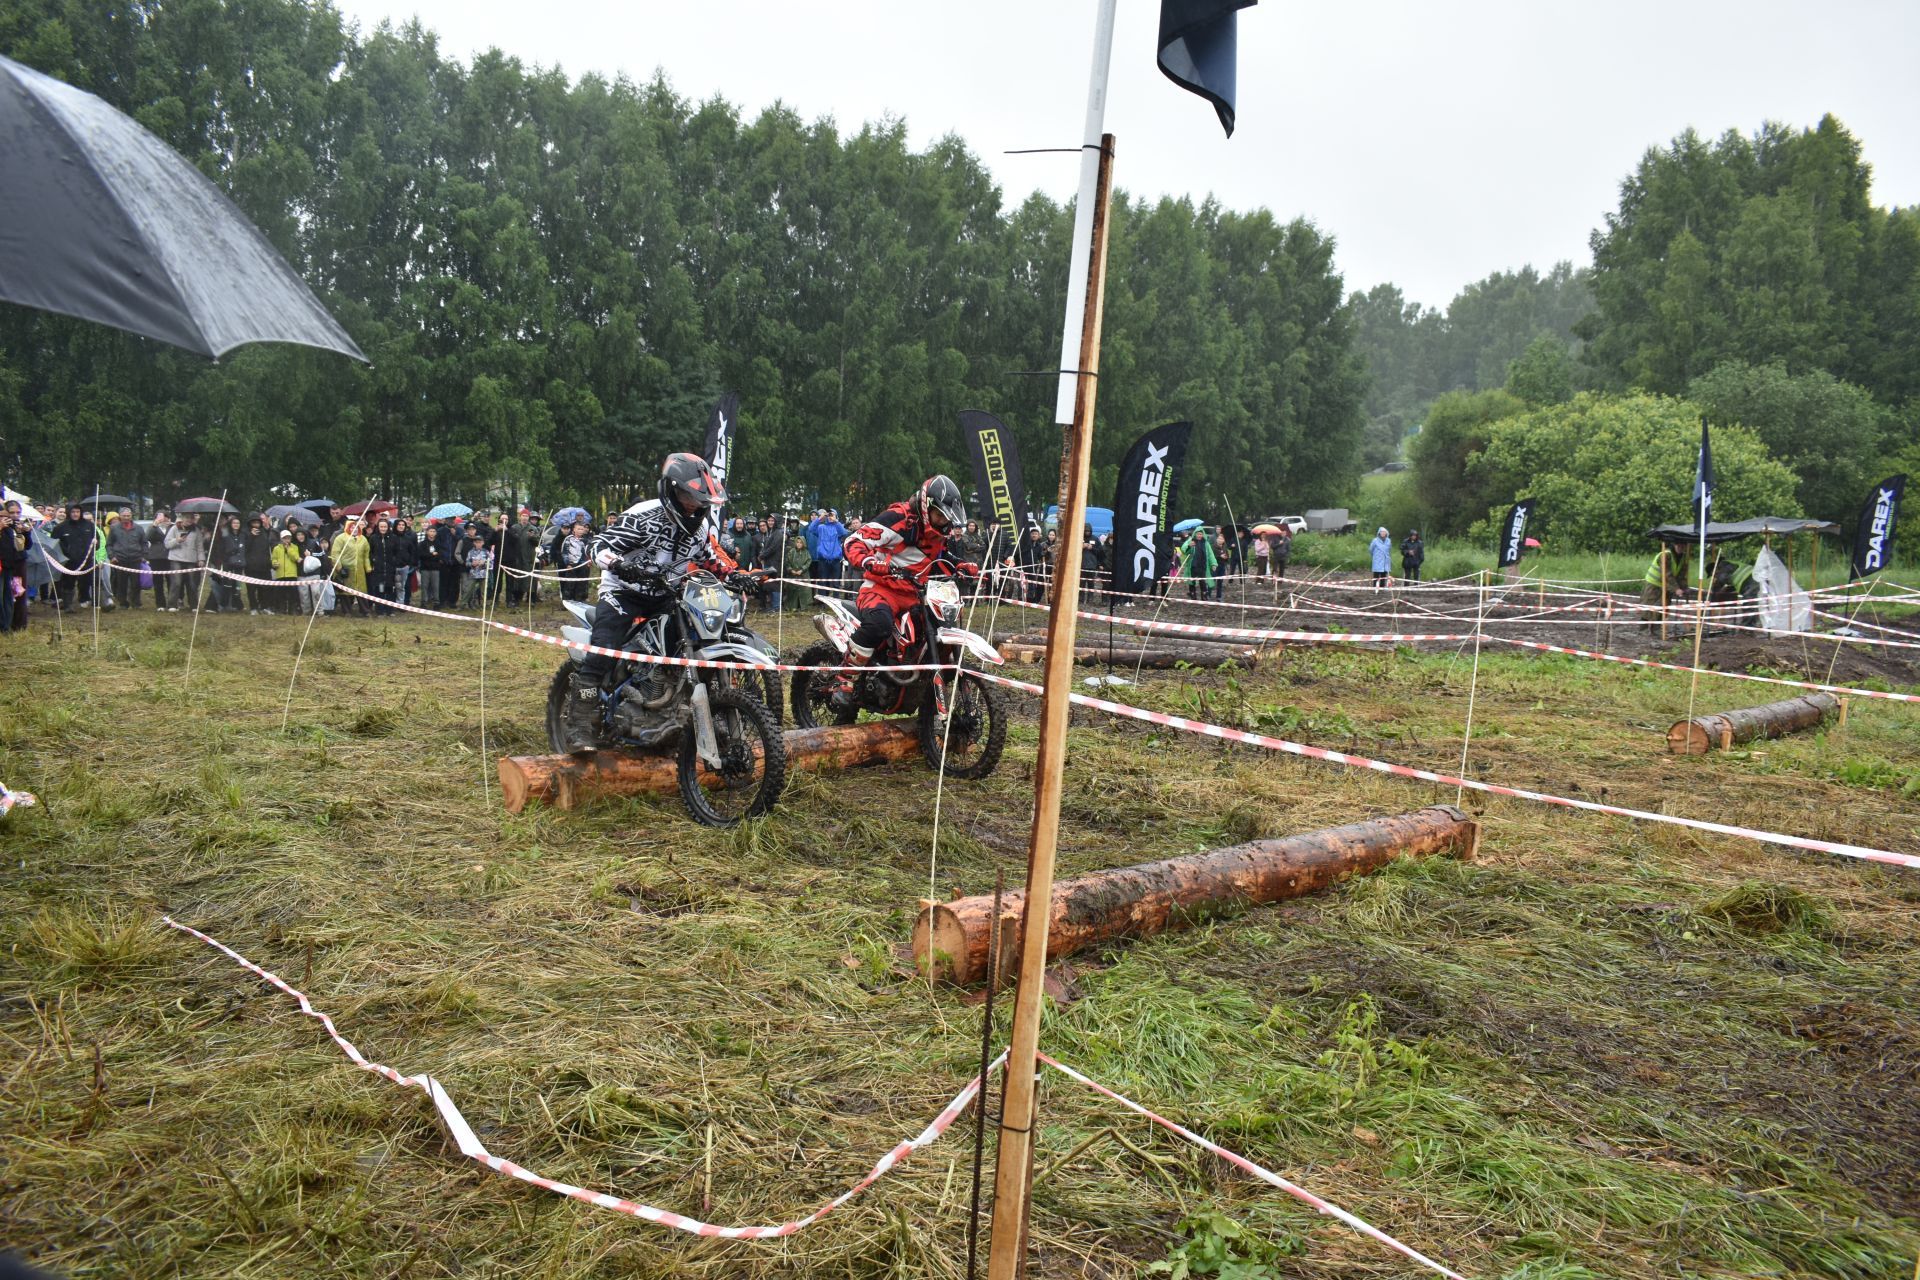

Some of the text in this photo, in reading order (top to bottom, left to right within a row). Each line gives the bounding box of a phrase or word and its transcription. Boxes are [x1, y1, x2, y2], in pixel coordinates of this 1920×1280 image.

[1134, 440, 1169, 583] DAREX
[1159, 465, 1173, 533] DAREXMOTO.RU
[1865, 488, 1893, 569] DAREX
[645, 519, 705, 548] DAEX
[658, 539, 691, 556] MOO
[1507, 505, 1527, 561] DAREX
